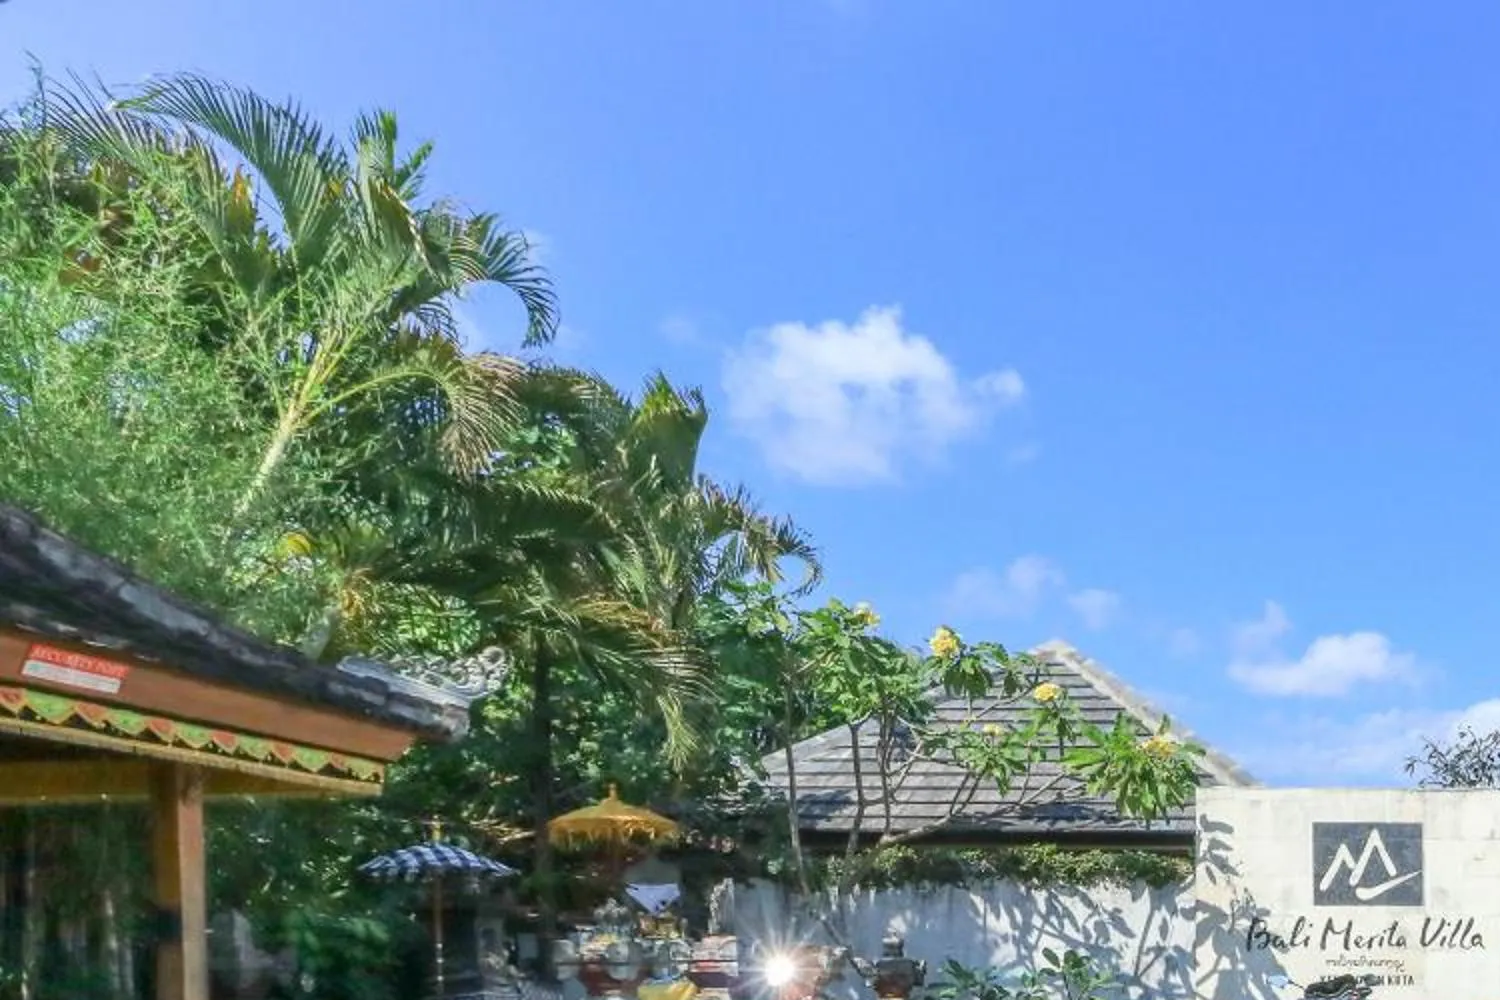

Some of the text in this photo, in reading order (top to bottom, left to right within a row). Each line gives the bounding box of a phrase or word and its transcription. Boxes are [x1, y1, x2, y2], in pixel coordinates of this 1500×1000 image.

[1246, 914, 1486, 951] Bali Merita Villa
